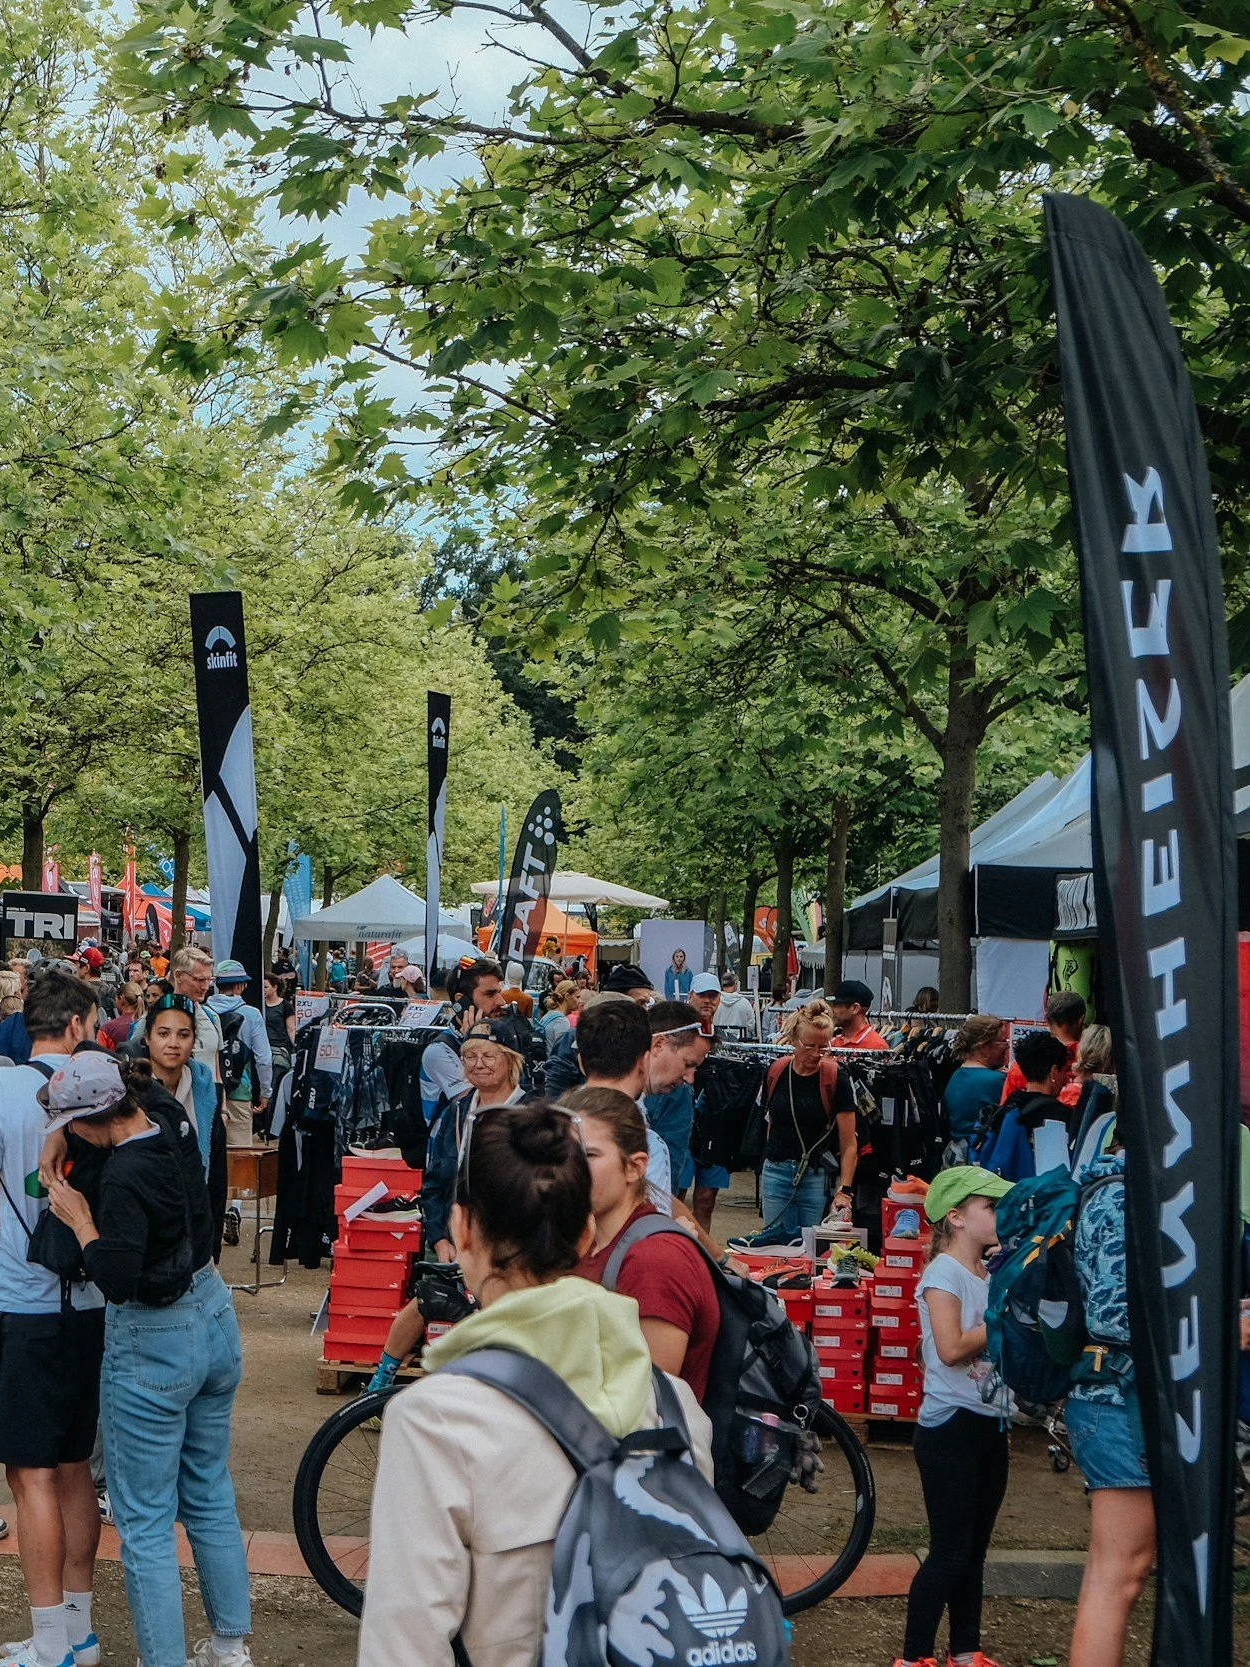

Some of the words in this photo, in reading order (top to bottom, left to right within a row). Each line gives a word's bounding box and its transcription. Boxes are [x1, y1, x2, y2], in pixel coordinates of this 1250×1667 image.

[206, 651, 238, 670] skinfit
[6, 911, 75, 939] TRI
[358, 927, 402, 940] naturafit
[1013, 1028, 1031, 1036] 2X
[686, 1638, 757, 1667] adidas
